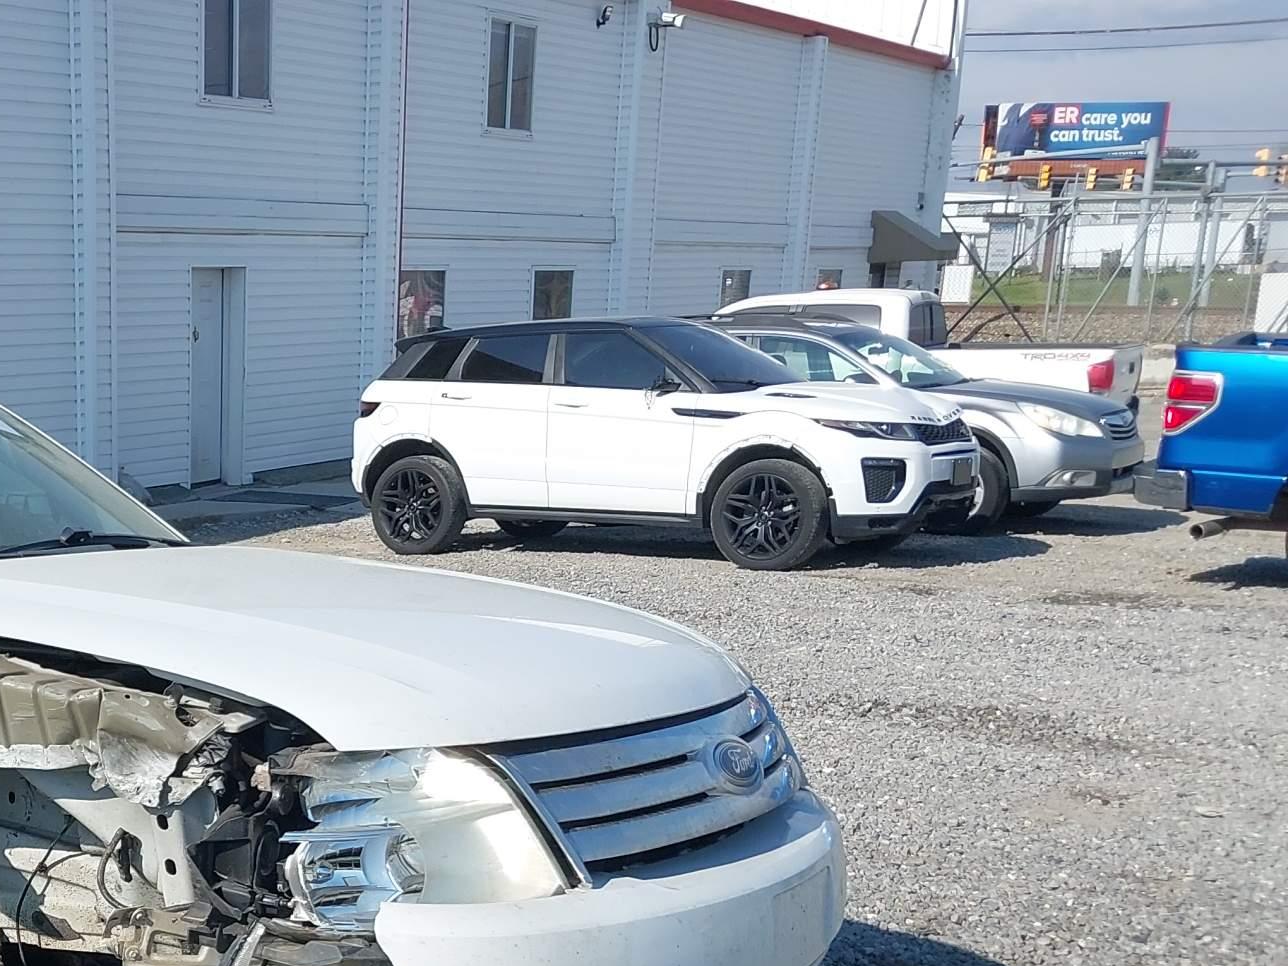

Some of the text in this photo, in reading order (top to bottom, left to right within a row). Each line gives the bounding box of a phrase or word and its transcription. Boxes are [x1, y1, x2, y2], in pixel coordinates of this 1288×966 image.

[1054, 106, 1080, 123] ER
[1082, 112, 1117, 125] care
[1121, 112, 1152, 128] you
[1050, 128, 1123, 142] can trust.
[727, 749, 756, 774] Ford
